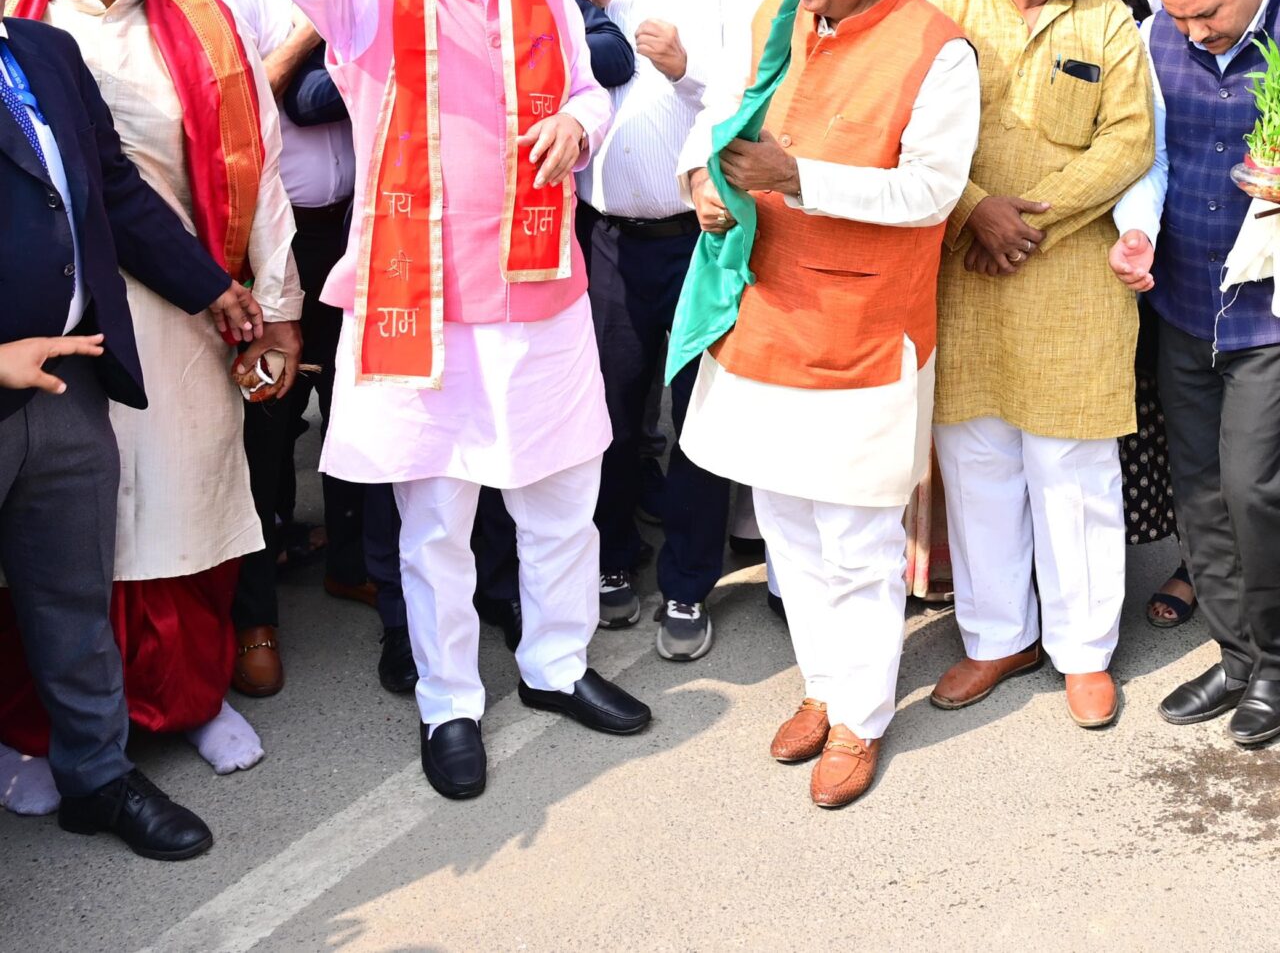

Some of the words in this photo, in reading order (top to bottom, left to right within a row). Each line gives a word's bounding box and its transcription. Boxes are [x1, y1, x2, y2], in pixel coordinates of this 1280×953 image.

[529, 93, 556, 118] जय
[522, 206, 557, 236] राम
[385, 250, 414, 281] श्री
[377, 307, 420, 338] राम
